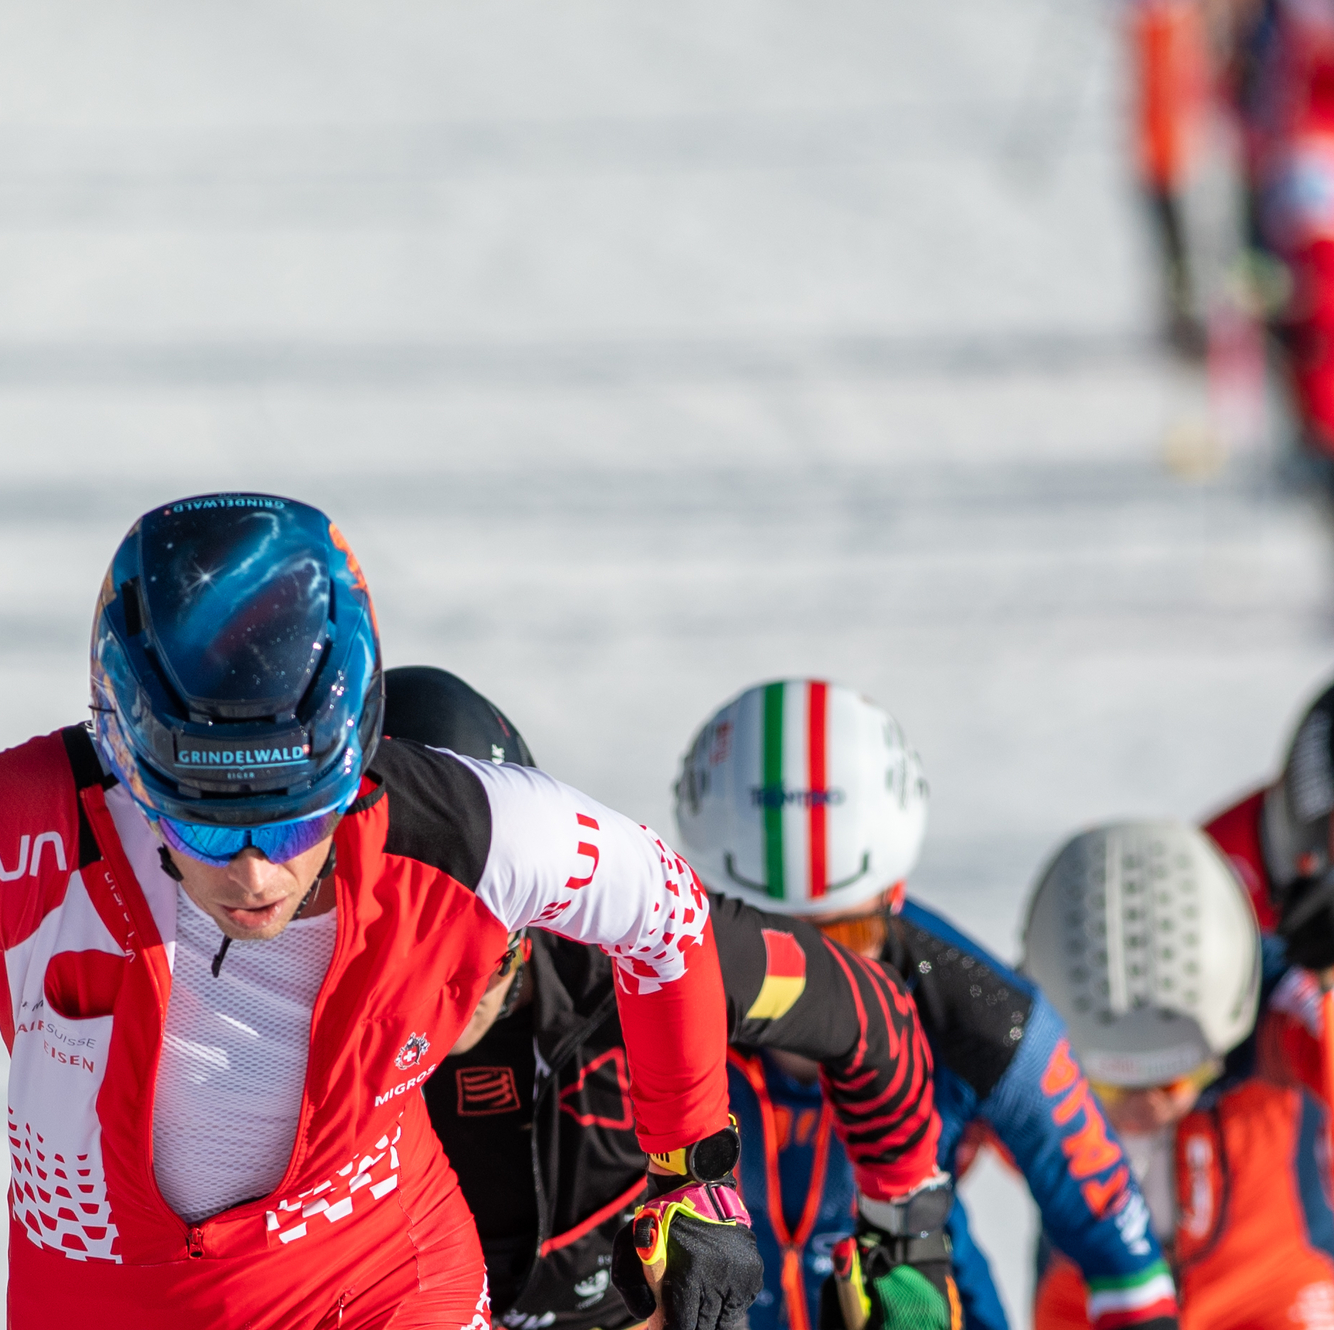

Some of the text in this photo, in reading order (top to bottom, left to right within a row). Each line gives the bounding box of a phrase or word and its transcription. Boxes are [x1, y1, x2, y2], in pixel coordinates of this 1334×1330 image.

[173, 499, 285, 513] GRINDELWALD
[178, 746, 304, 764] GRINDELWALD
[46, 1023, 96, 1049] SUISSE
[375, 1063, 436, 1107] MIGROS
